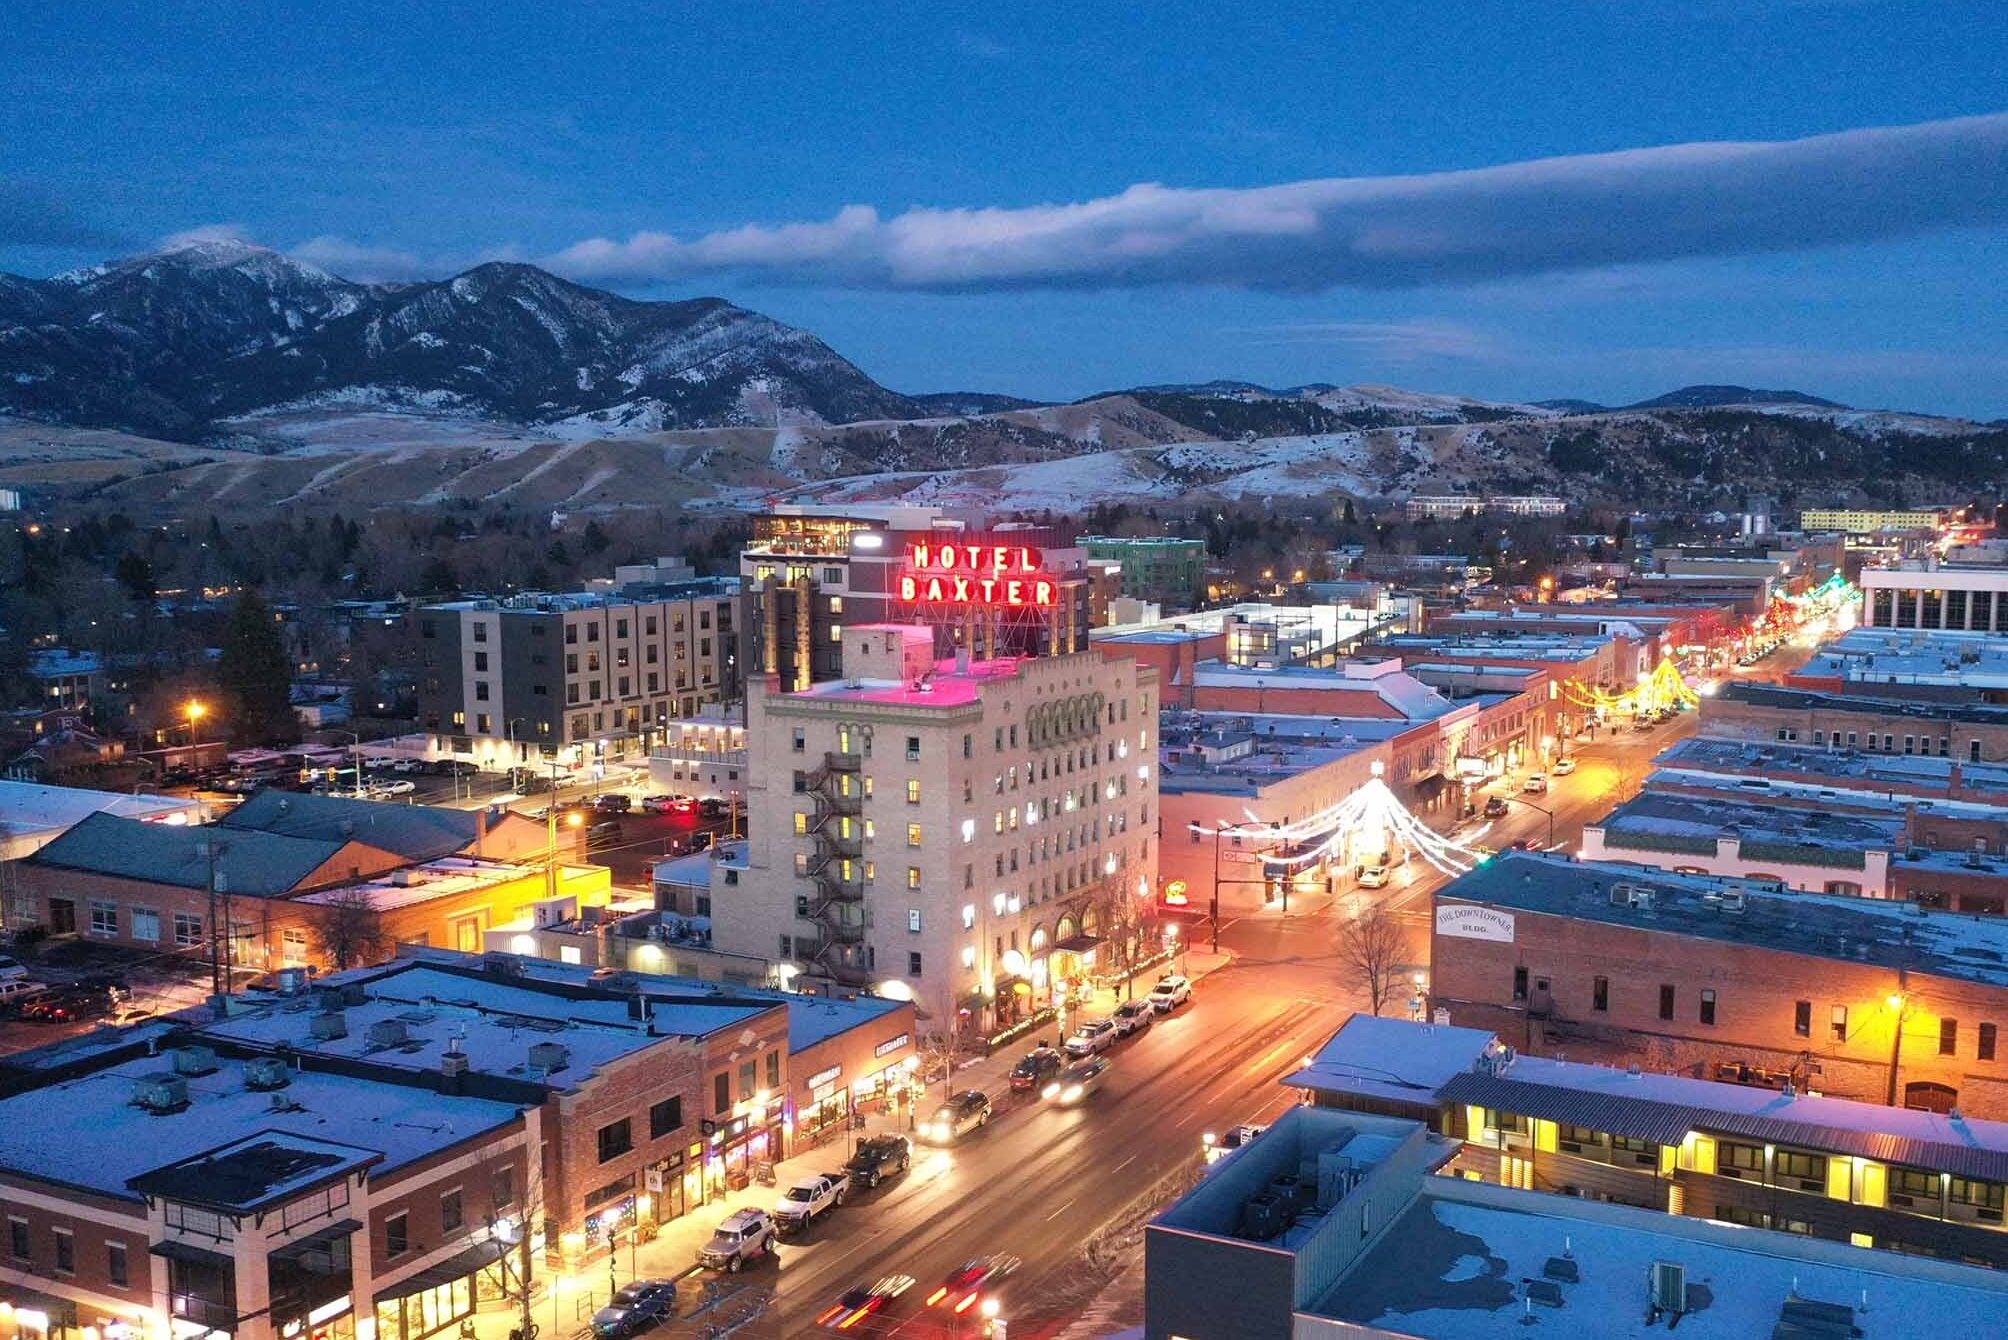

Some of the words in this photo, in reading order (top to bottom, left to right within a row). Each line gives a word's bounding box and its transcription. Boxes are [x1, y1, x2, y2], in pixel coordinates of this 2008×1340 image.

[913, 544, 1037, 572] HOTEL
[900, 576, 1052, 605] BAXTER
[1439, 912, 1454, 924] THE
